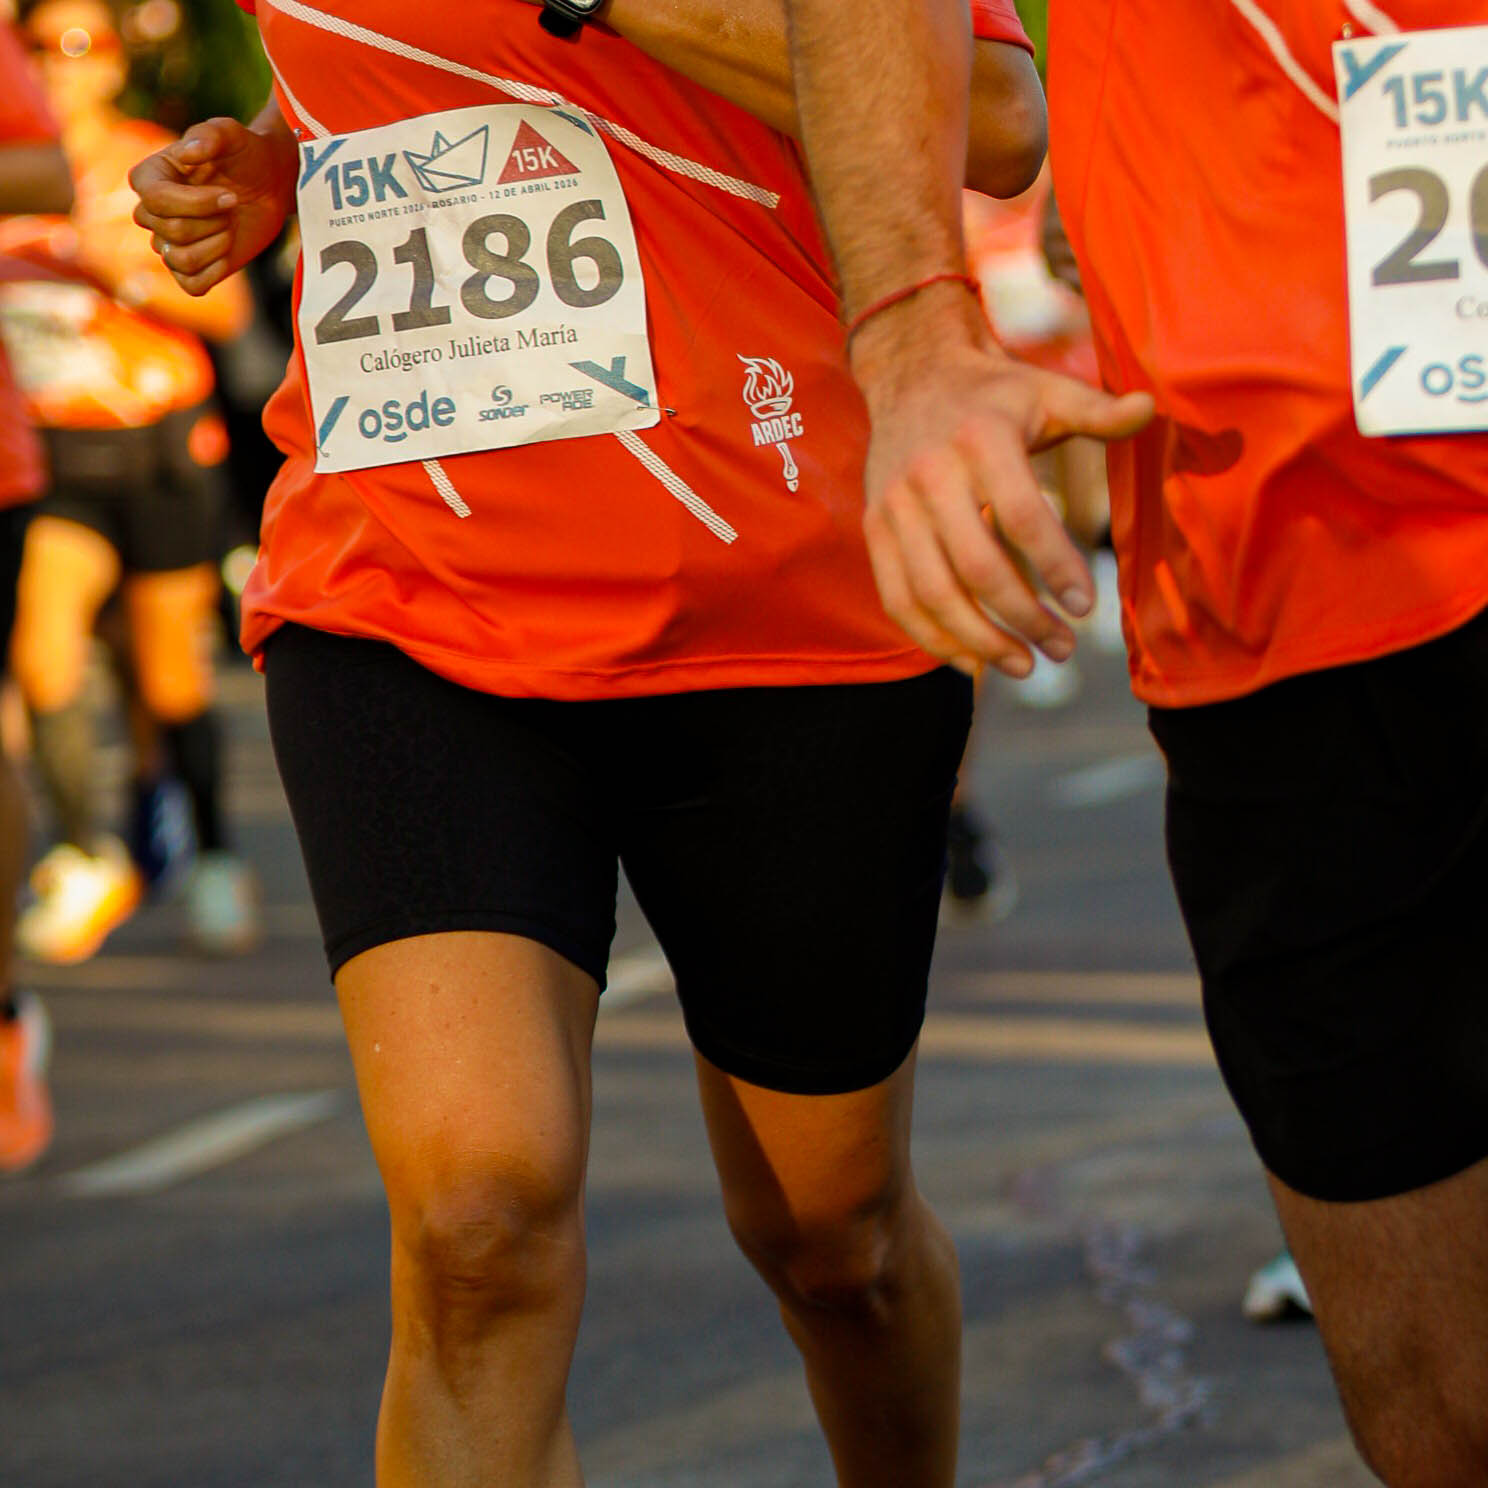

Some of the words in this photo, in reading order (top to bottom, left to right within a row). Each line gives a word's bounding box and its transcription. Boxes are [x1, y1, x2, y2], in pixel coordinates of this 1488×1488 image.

[324, 152, 408, 211] 15K
[511, 145, 560, 173] 15K
[329, 213, 366, 227] PUERTO
[367, 207, 400, 220] NORTE
[431, 193, 478, 209] ROSARIO
[489, 190, 501, 200] 12
[504, 187, 517, 197] DE
[520, 182, 551, 194] ABRIL
[554, 178, 578, 190] 2026
[314, 199, 625, 345] 2186
[359, 346, 443, 374] Calógero
[448, 335, 511, 360] Julieta
[516, 323, 579, 350] María
[358, 389, 457, 443] osde
[539, 388, 594, 404] POWER
[750, 412, 804, 447] ARDEC
